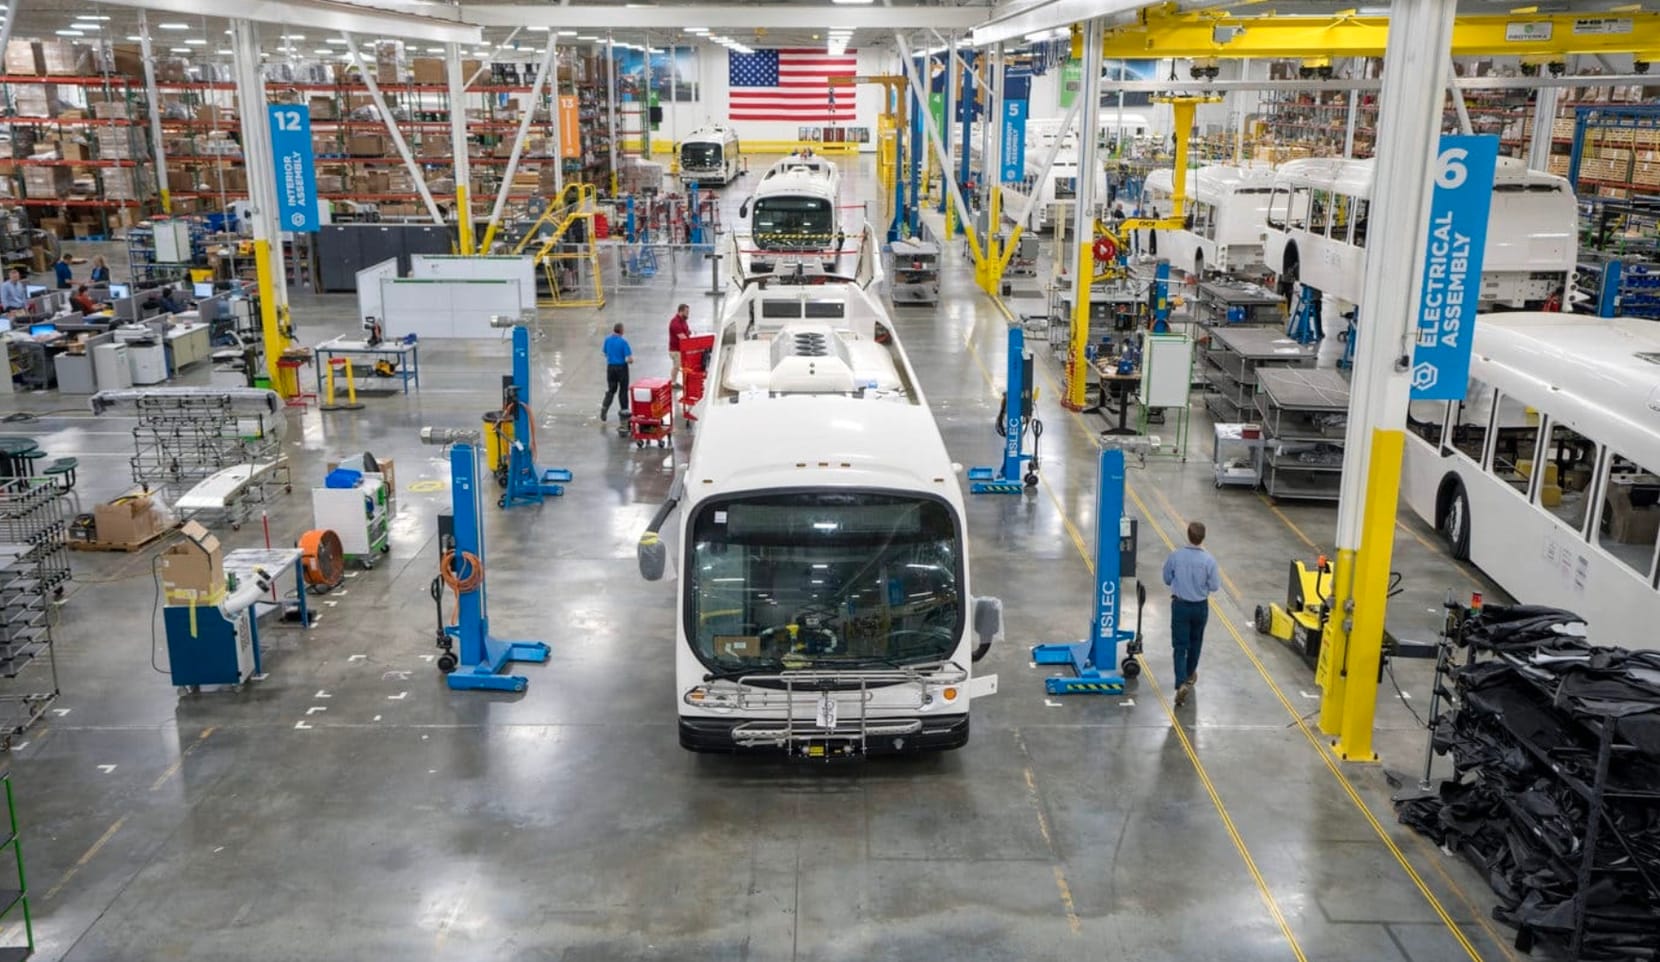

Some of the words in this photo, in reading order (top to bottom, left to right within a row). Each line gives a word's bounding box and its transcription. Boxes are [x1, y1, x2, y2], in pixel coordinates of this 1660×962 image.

[273, 111, 302, 131] 12
[561, 98, 574, 108] 13
[1008, 103, 1019, 117] 5
[283, 156, 296, 206] INTERIOR
[292, 151, 306, 206] ASSEMBLY
[1435, 147, 1469, 189] 6
[1416, 211, 1453, 348] ELECTRICAL
[1441, 232, 1471, 348] ASSEMBLY
